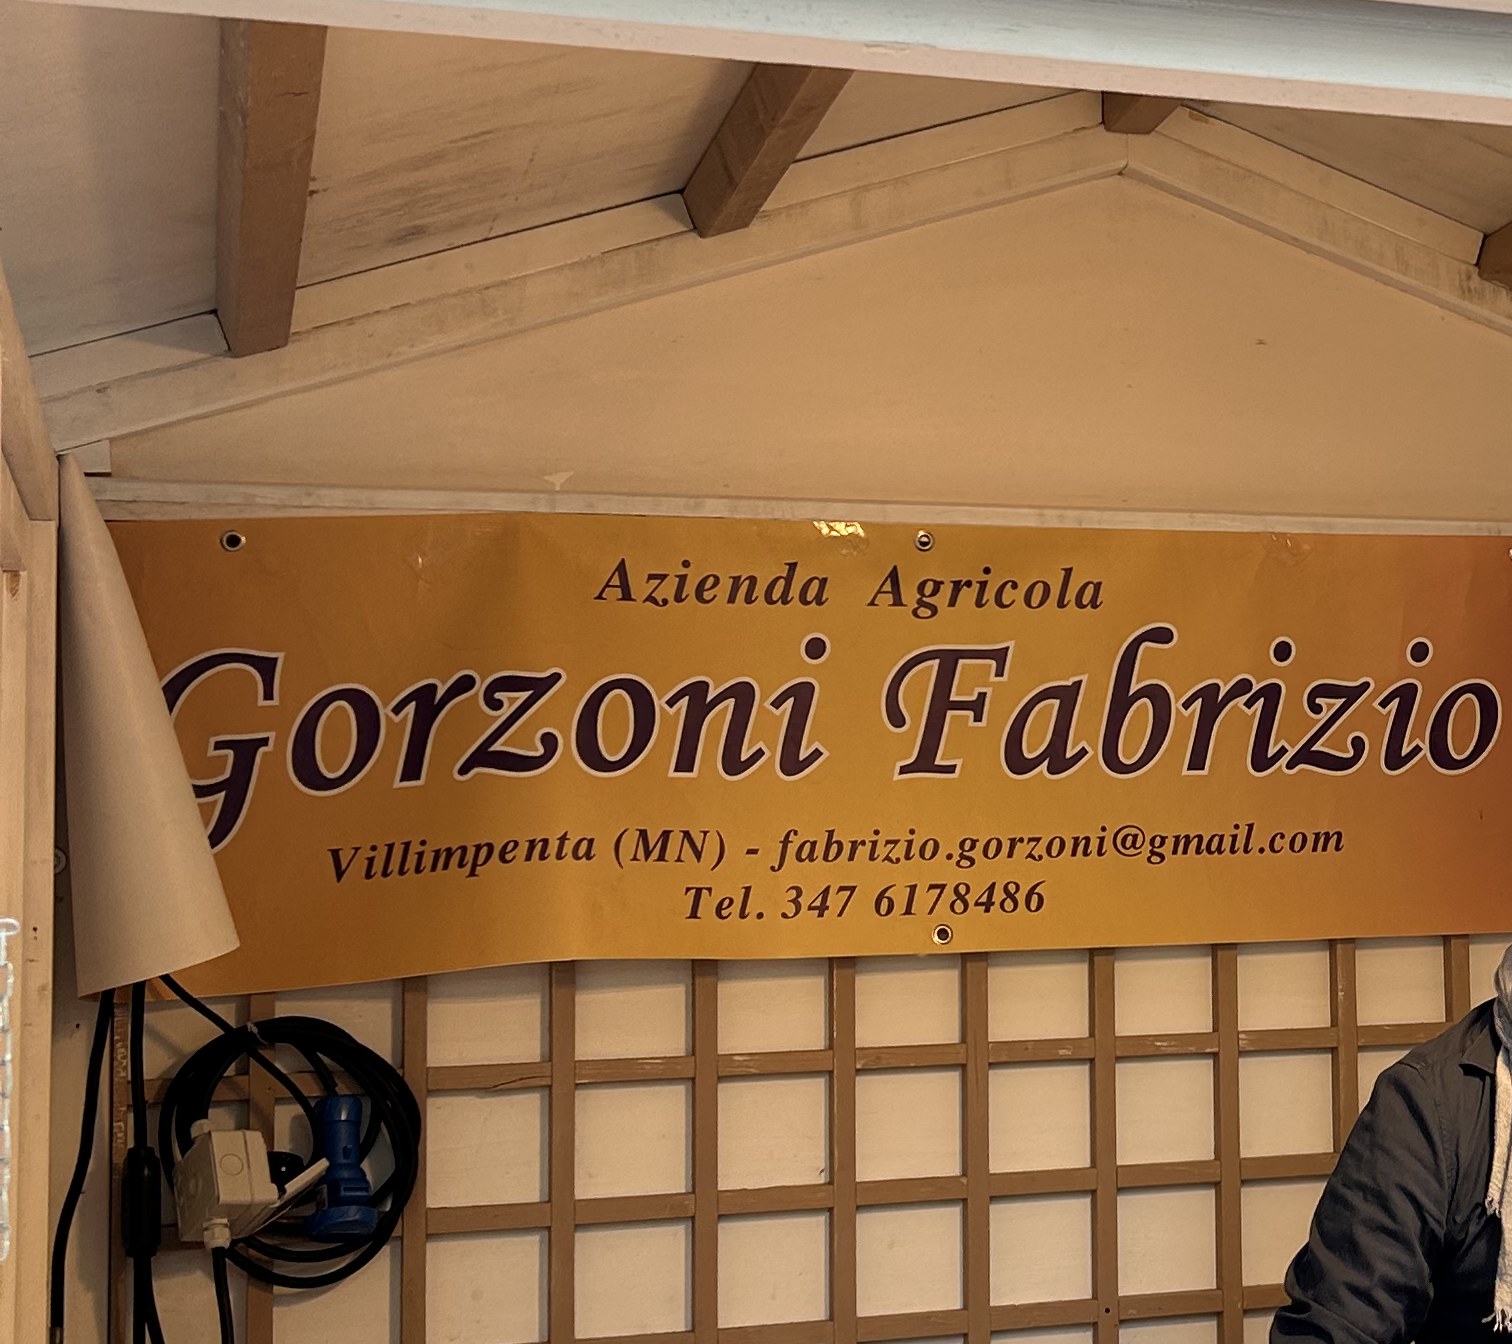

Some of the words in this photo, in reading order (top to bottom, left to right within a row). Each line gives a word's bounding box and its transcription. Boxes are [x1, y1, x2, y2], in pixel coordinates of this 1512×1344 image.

[594, 558, 829, 606] Azienda
[867, 564, 1103, 619] Agricola
[160, 632, 830, 855] Gorzoni
[881, 622, 1502, 781] Fabrizio
[327, 828, 596, 883] Villimpenta
[613, 828, 727, 870] (MN)
[770, 822, 1345, 872] fabrizio.gorzoni@gmail.com
[684, 885, 765, 920] Tel.
[780, 884, 858, 919] 347
[873, 880, 1047, 916] 6178486
